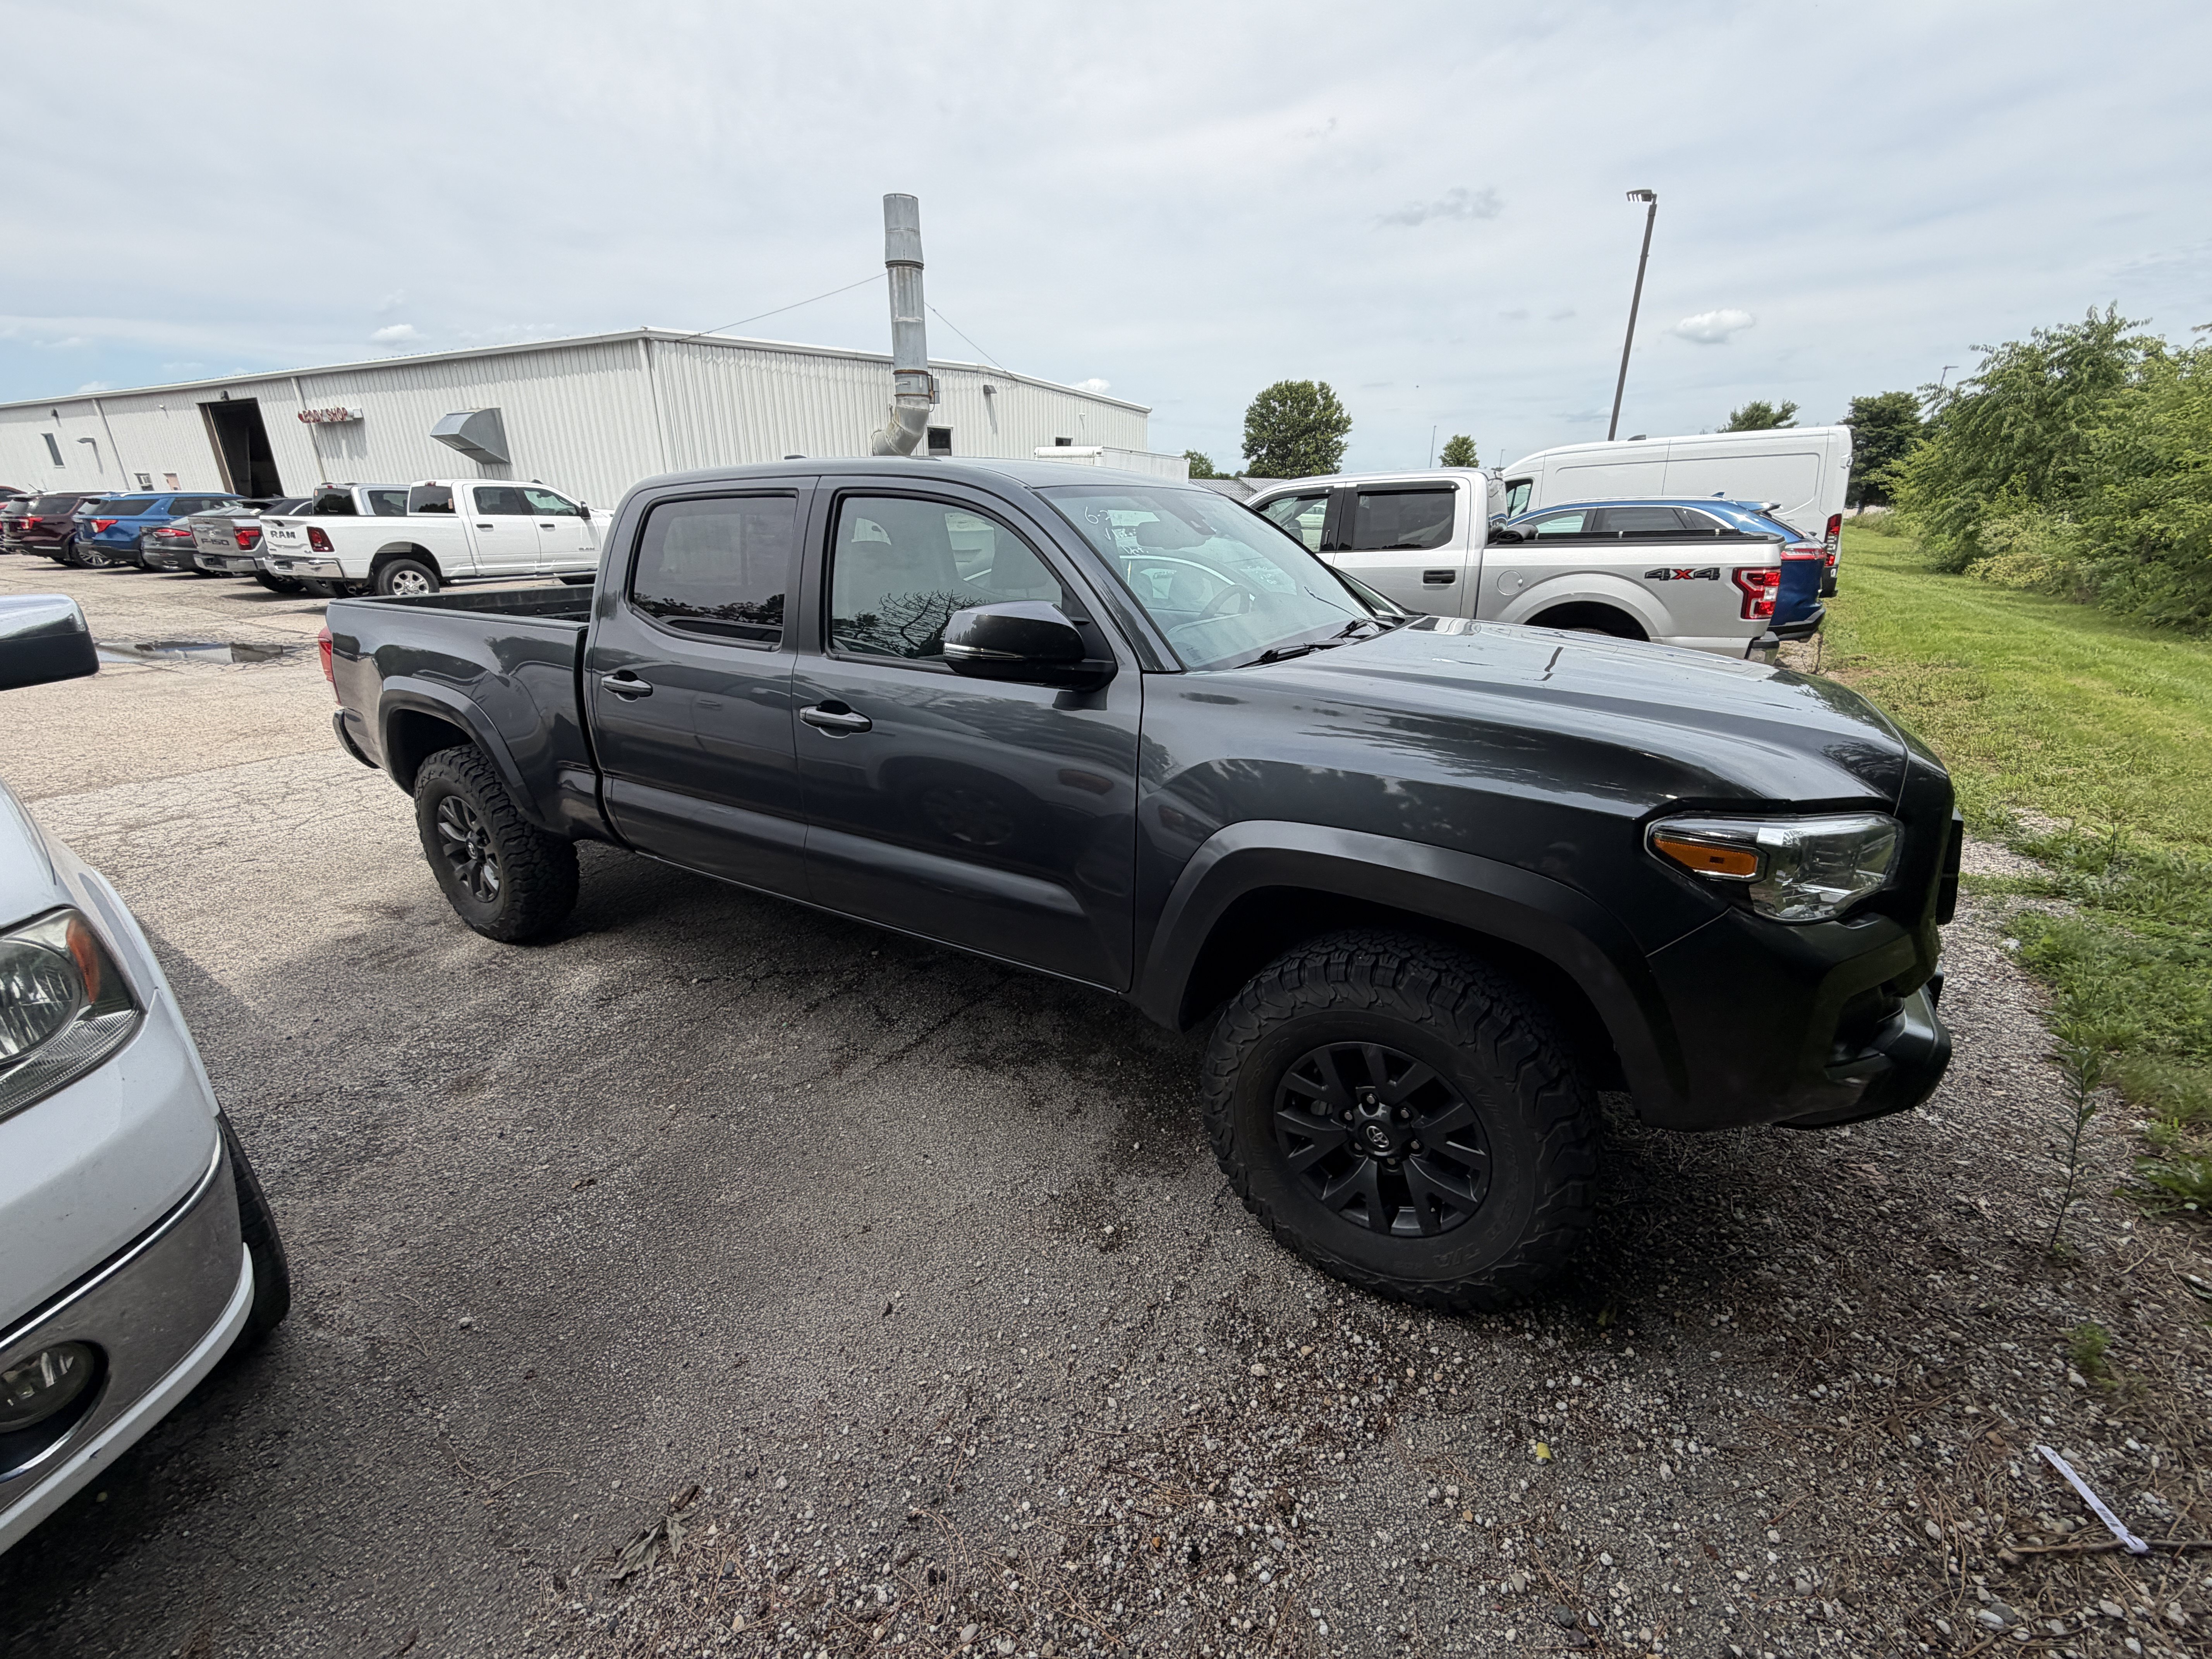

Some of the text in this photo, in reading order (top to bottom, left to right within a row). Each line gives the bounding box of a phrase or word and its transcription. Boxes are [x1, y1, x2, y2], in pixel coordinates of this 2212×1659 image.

[302, 407, 348, 423] BODY SHOP
[270, 531, 296, 539] RAM
